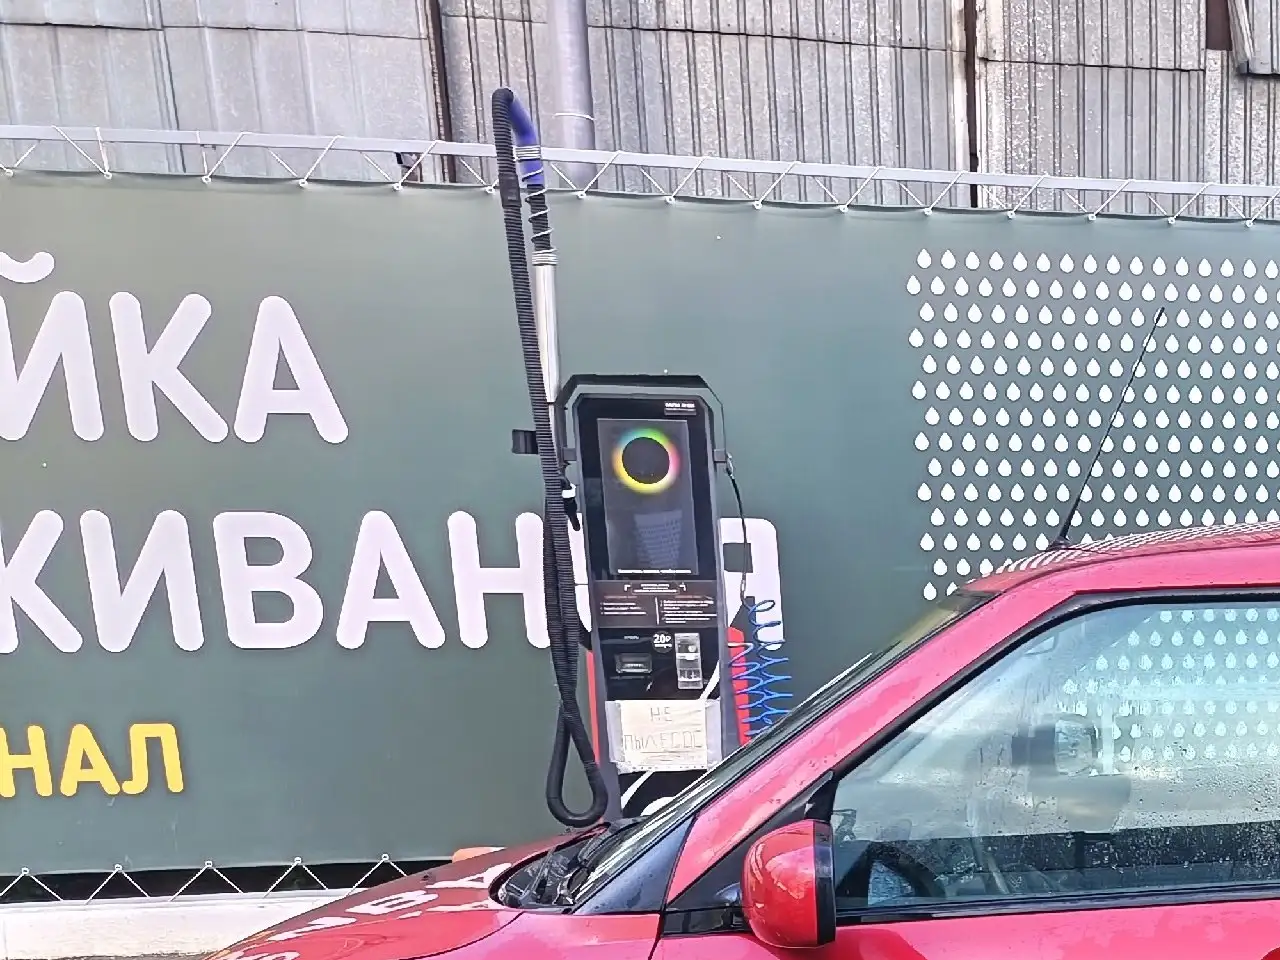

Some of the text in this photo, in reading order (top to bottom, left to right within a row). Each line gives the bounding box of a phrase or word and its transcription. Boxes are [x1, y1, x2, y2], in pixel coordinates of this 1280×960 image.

[0, 251, 349, 444] ЙКА
[650, 706, 673, 722] НЕ
[0, 723, 184, 798] НАЛ
